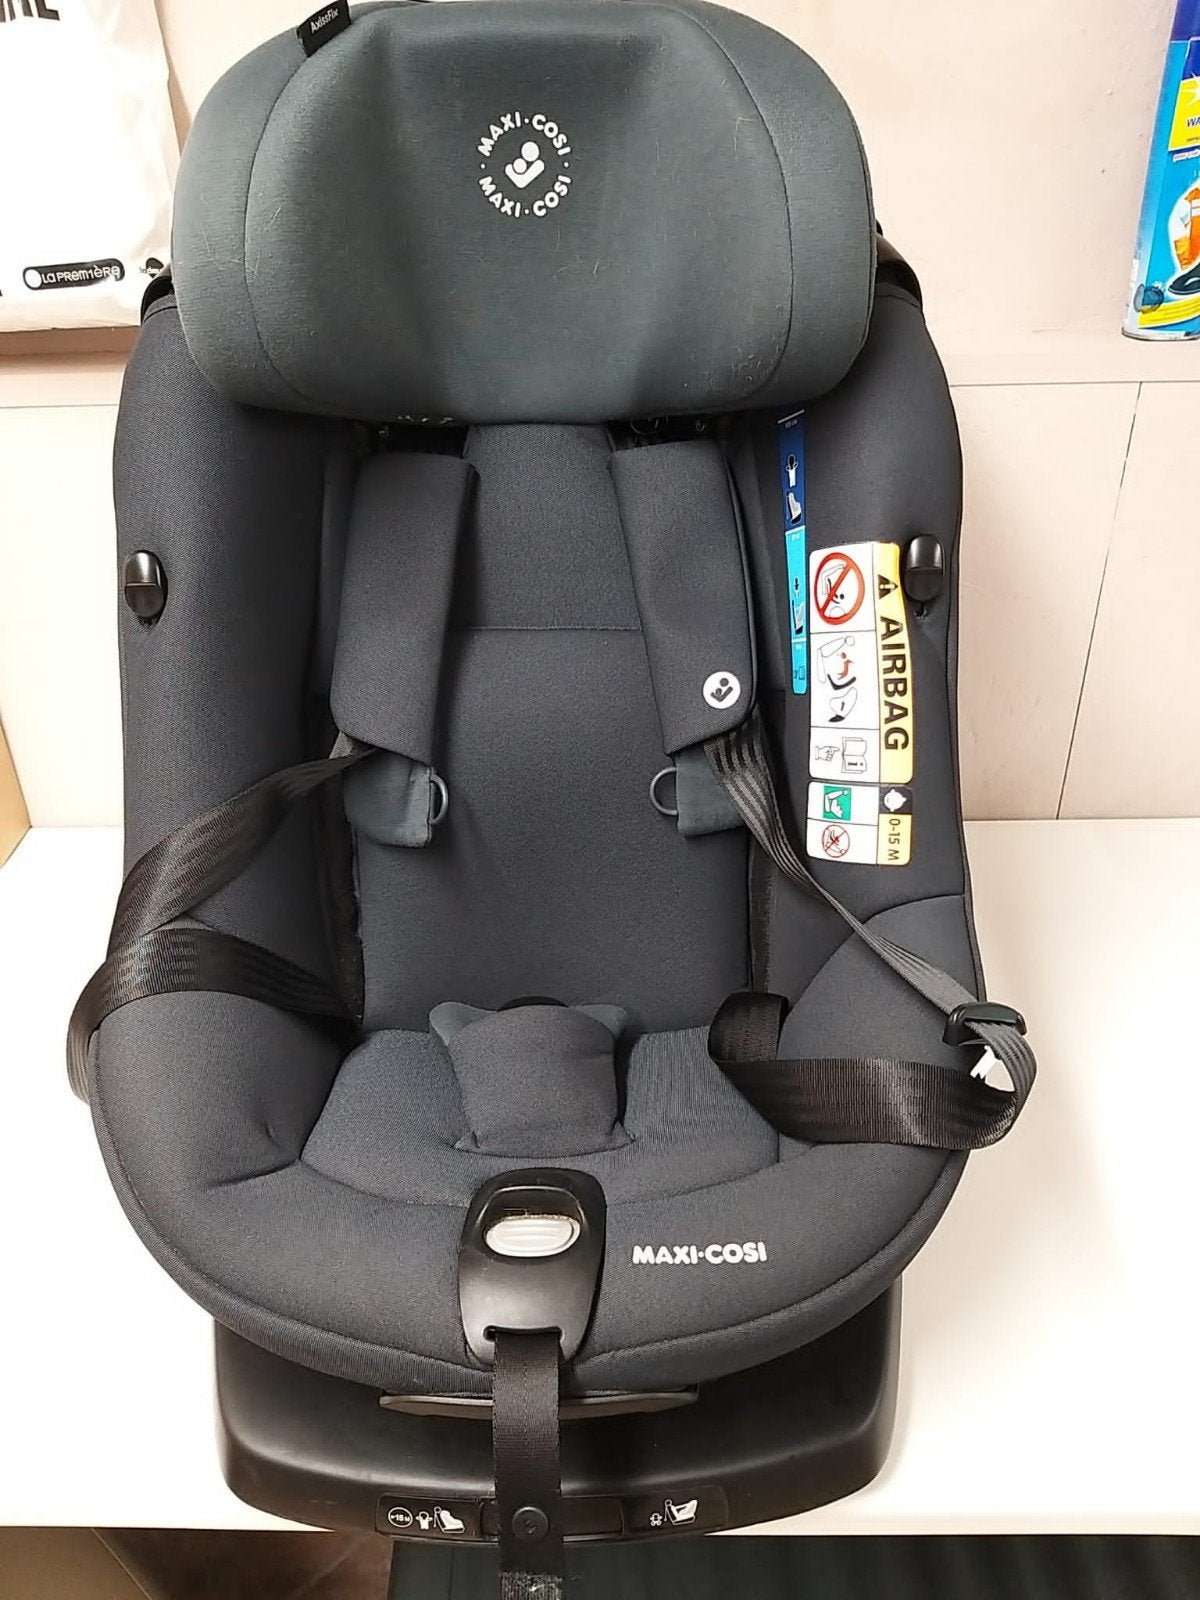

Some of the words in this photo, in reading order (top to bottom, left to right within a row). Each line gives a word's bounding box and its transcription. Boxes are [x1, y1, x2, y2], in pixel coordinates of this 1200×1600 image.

[310, 9, 339, 34] AxissFix
[880, 615, 909, 750] AIRBAG
[888, 818, 901, 845] 0-15
[887, 848, 900, 861] M
